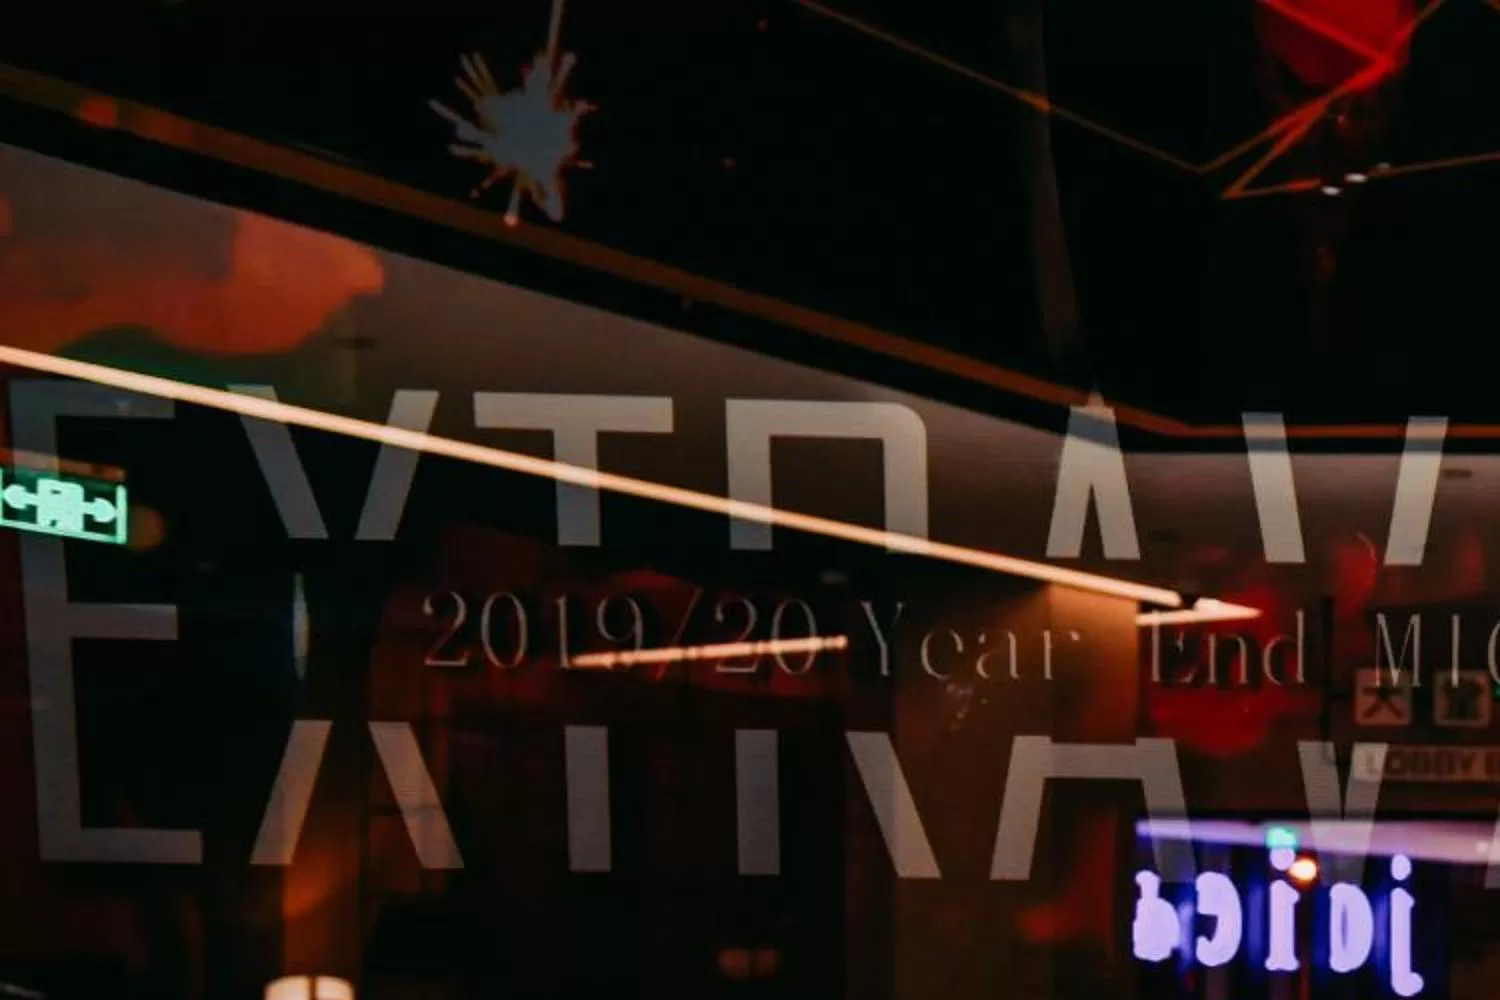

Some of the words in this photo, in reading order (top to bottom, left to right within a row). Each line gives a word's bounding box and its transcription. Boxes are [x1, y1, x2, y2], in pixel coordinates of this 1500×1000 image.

[422, 590, 820, 680] 2019/20
[860, 600, 1082, 682] Year
[1148, 608, 1308, 688] End
